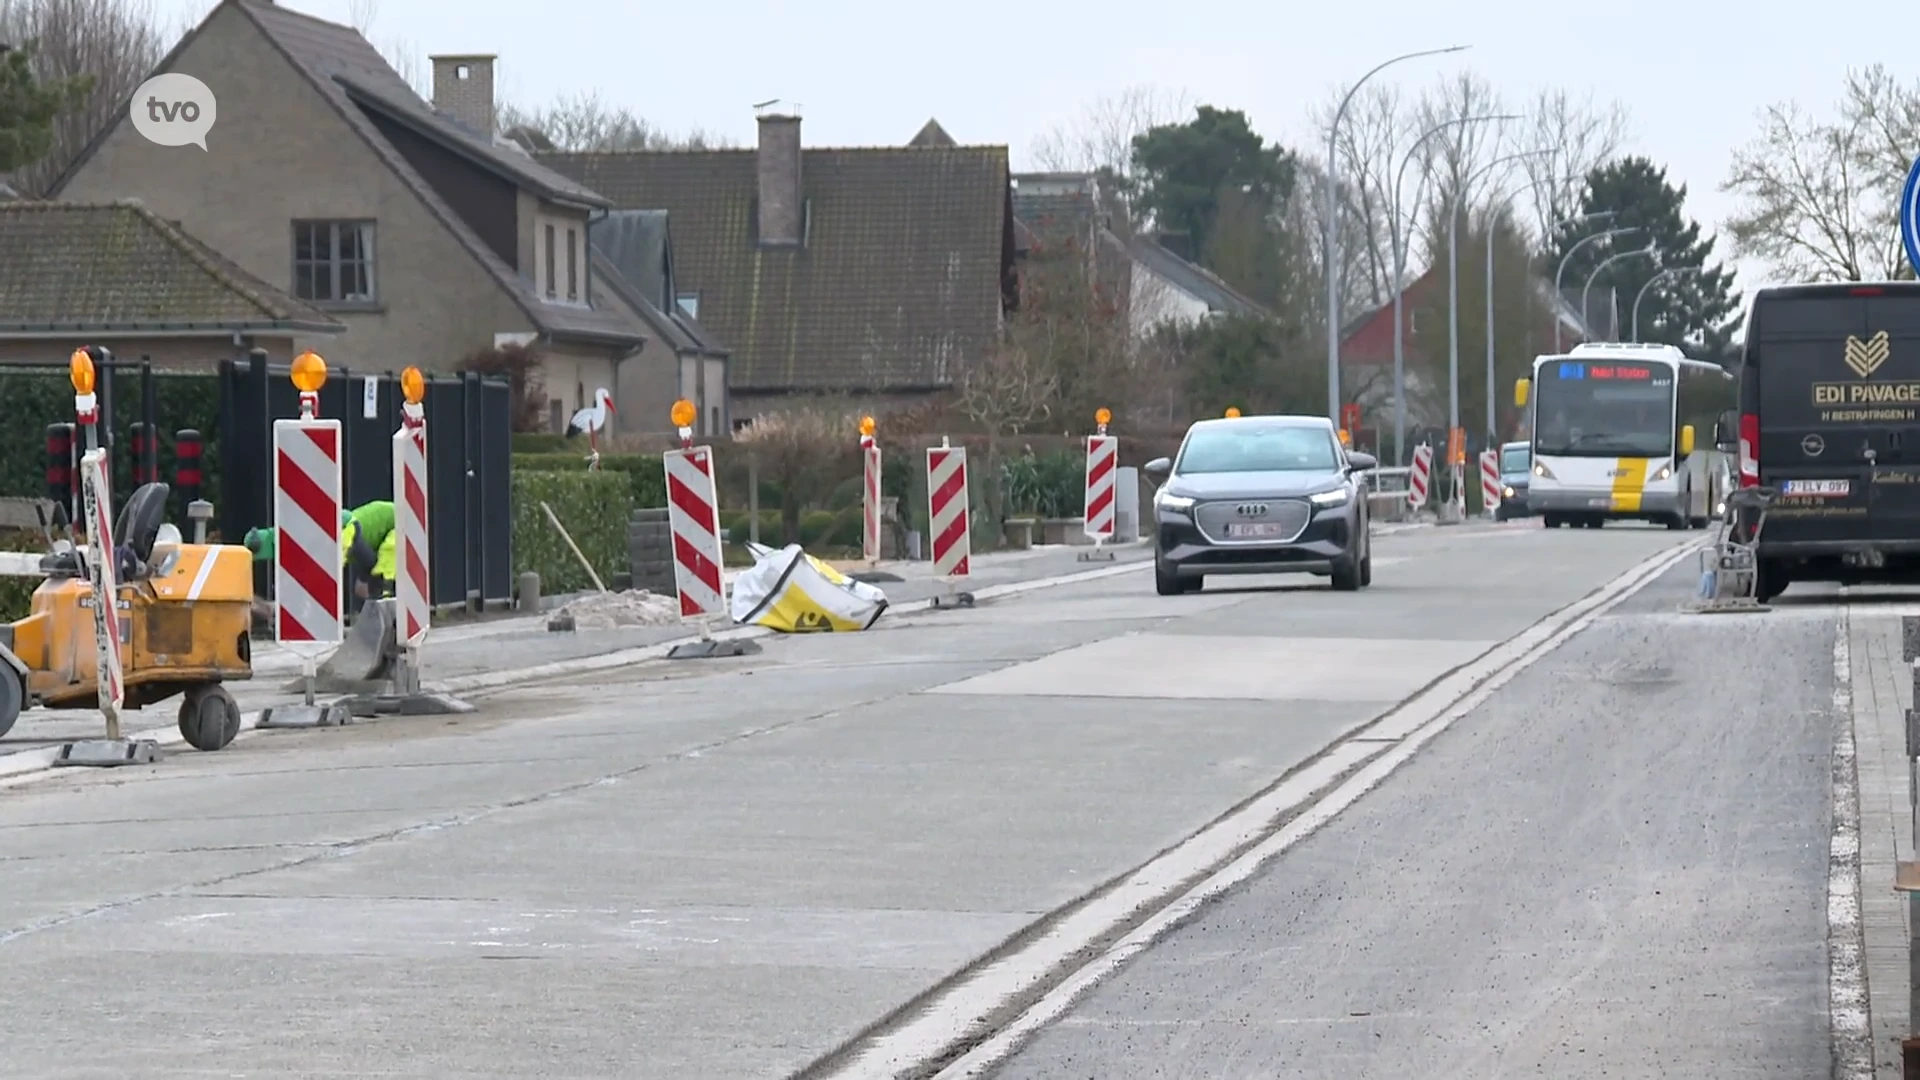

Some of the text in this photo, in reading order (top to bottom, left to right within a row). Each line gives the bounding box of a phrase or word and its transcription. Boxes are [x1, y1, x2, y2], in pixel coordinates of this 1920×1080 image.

[1815, 384, 1920, 403] EDI PAVAGE
[1832, 410, 1905, 421] BESTRATINGEN
